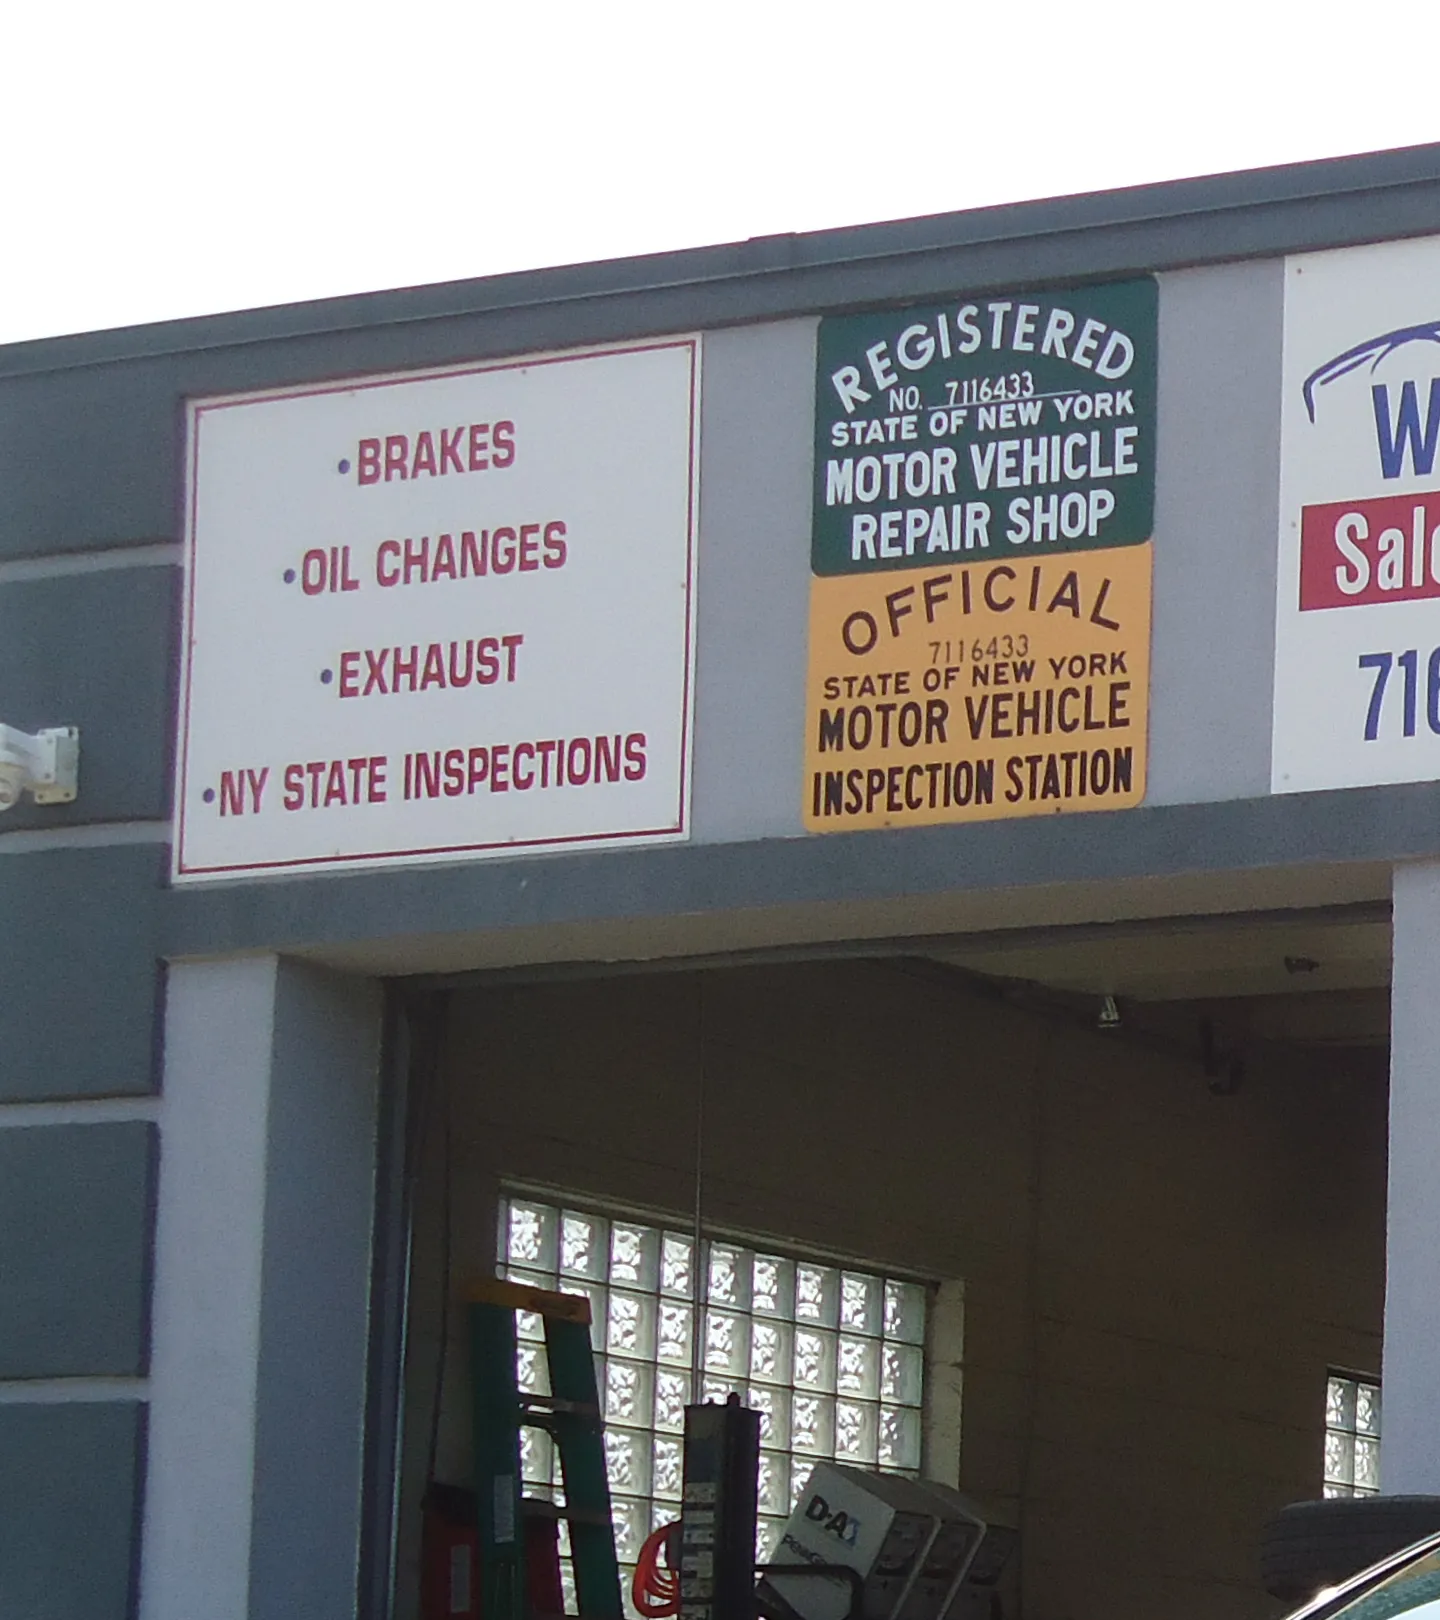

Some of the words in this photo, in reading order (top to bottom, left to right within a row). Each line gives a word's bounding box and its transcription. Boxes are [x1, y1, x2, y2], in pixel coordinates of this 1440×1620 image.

[831, 302, 1135, 414] REGISTERED
[944, 371, 1035, 407] 7116433
[357, 420, 517, 486] BRAKES
[831, 415, 918, 447] STATE
[929, 409, 967, 437] OF
[977, 400, 1043, 431] NEW
[1053, 389, 1134, 423] YORK
[826, 447, 958, 506] MOTOR
[970, 426, 1139, 491] VEHICLE
[301, 544, 360, 596] OIL
[375, 520, 569, 588] CHANGES
[851, 501, 991, 561] REPAIR
[1006, 489, 1115, 545] SHOP
[842, 565, 1120, 656] OFFICIAL
[338, 634, 524, 698] EXHAUST
[823, 671, 910, 700] STATE
[922, 666, 960, 692] OF
[971, 659, 1037, 688] NEW
[1048, 650, 1128, 681] YORK
[928, 634, 1030, 665] 7116433
[818, 698, 950, 753] MOTOR
[964, 681, 1131, 741] VEHICLE
[218, 767, 270, 817] NY
[283, 756, 388, 812] STATE
[403, 732, 648, 800] INSPECTIONS
[812, 759, 995, 818] INSPECTION
[1004, 746, 1133, 804] STATION
